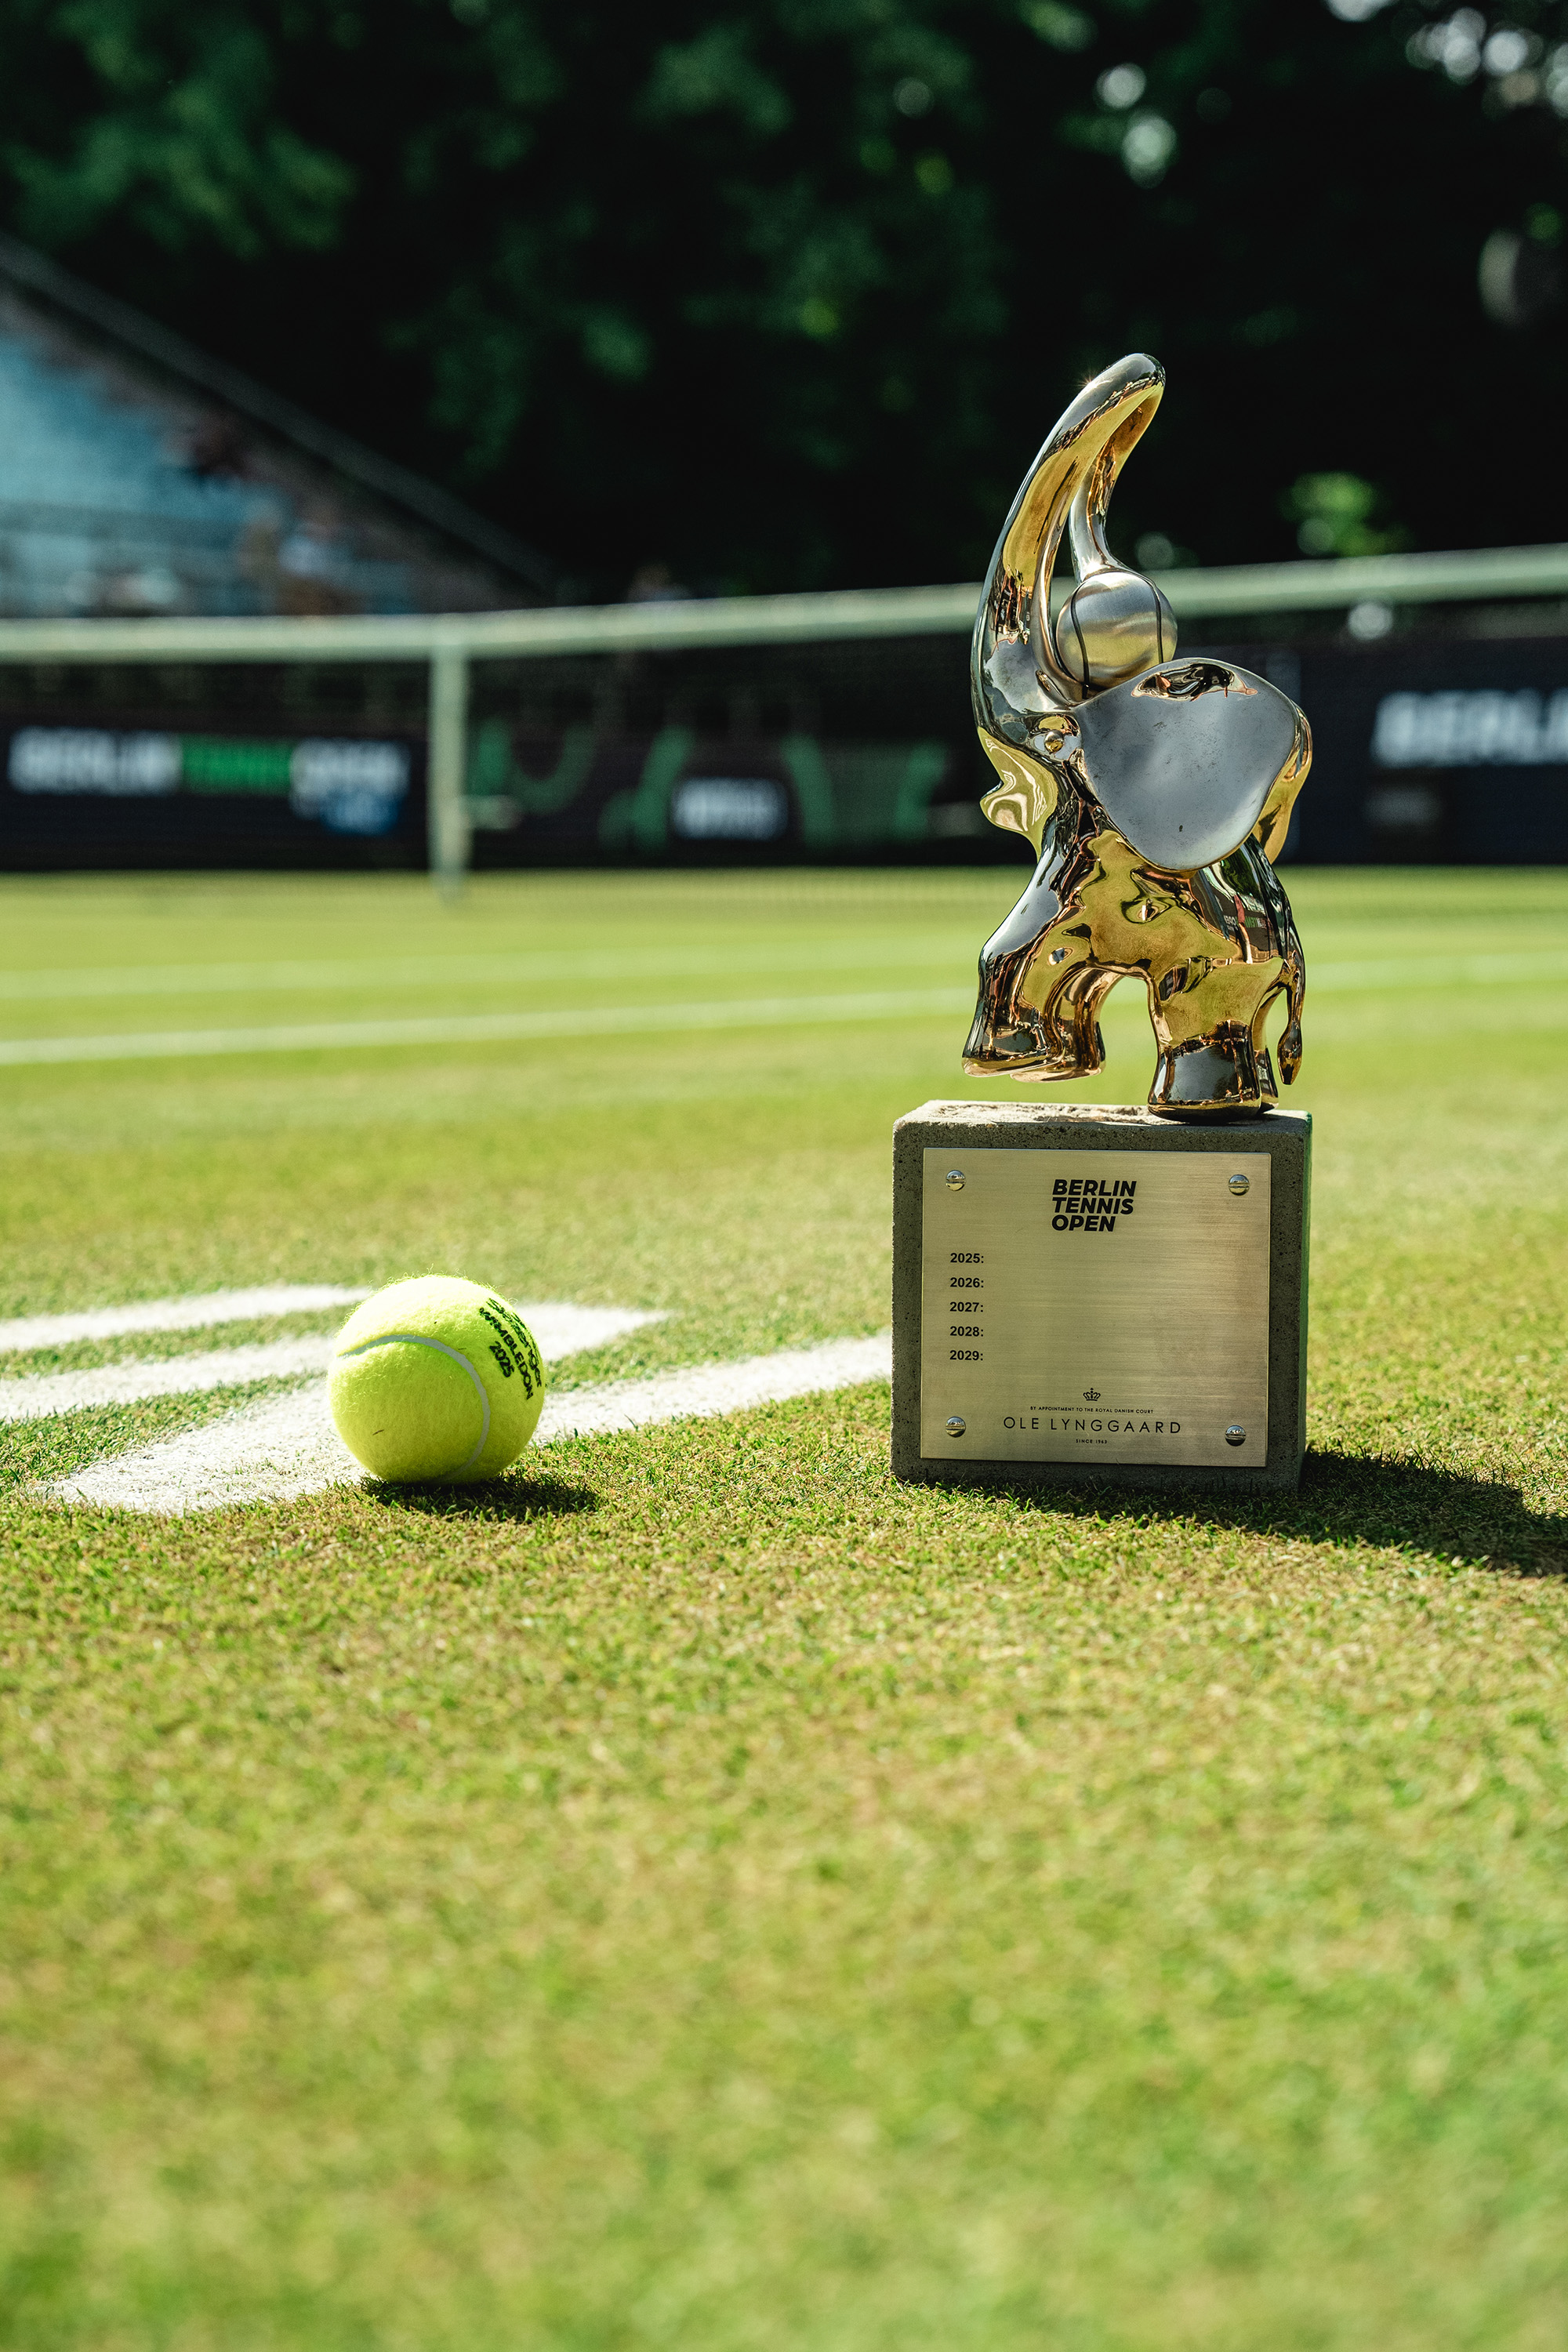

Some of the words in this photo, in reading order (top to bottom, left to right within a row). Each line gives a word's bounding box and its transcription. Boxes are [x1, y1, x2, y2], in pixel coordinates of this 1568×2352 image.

[1052, 1179, 1137, 1197] BERLIN
[1051, 1197, 1134, 1215] TENNIS
[1052, 1214, 1116, 1232] OPEN
[949, 1253, 984, 1263] 2025:
[949, 1277, 984, 1287] 2026:
[949, 1301, 984, 1312] 2027:
[949, 1326, 984, 1337] 2028:
[479, 1307, 533, 1400] WIMBLEDON
[489, 1341, 514, 1377] 2025
[949, 1350, 984, 1360] 2029:
[1004, 1417, 1039, 1429] OLE
[1051, 1418, 1180, 1433] LYNGGAARD
